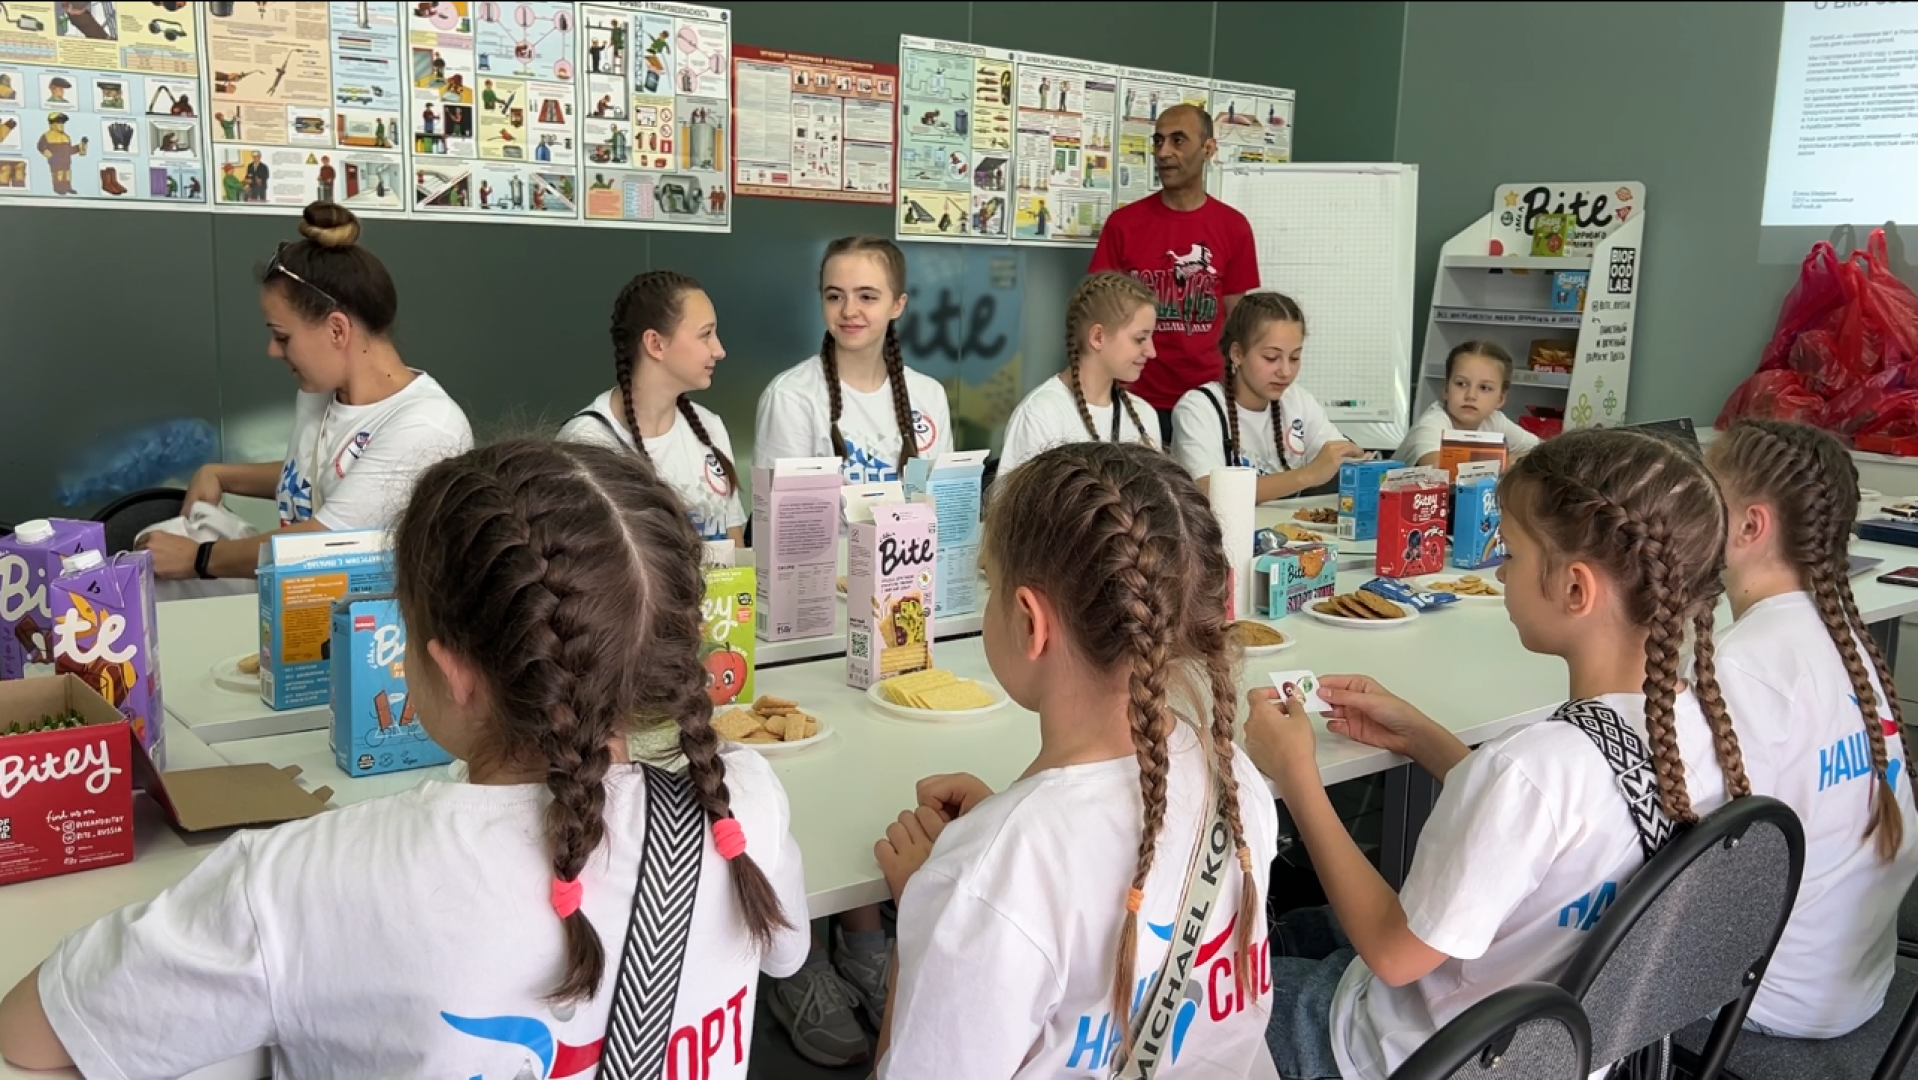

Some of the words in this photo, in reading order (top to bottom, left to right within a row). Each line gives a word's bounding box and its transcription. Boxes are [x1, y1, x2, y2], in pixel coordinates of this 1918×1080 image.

[1522, 186, 1613, 236] Bite
[900, 287, 1008, 362] ite
[878, 537, 934, 576] Bite
[0, 739, 123, 800] Bitey
[1199, 820, 1231, 887] KO
[1557, 880, 1617, 932] НА
[666, 983, 748, 1080] ОРТ
